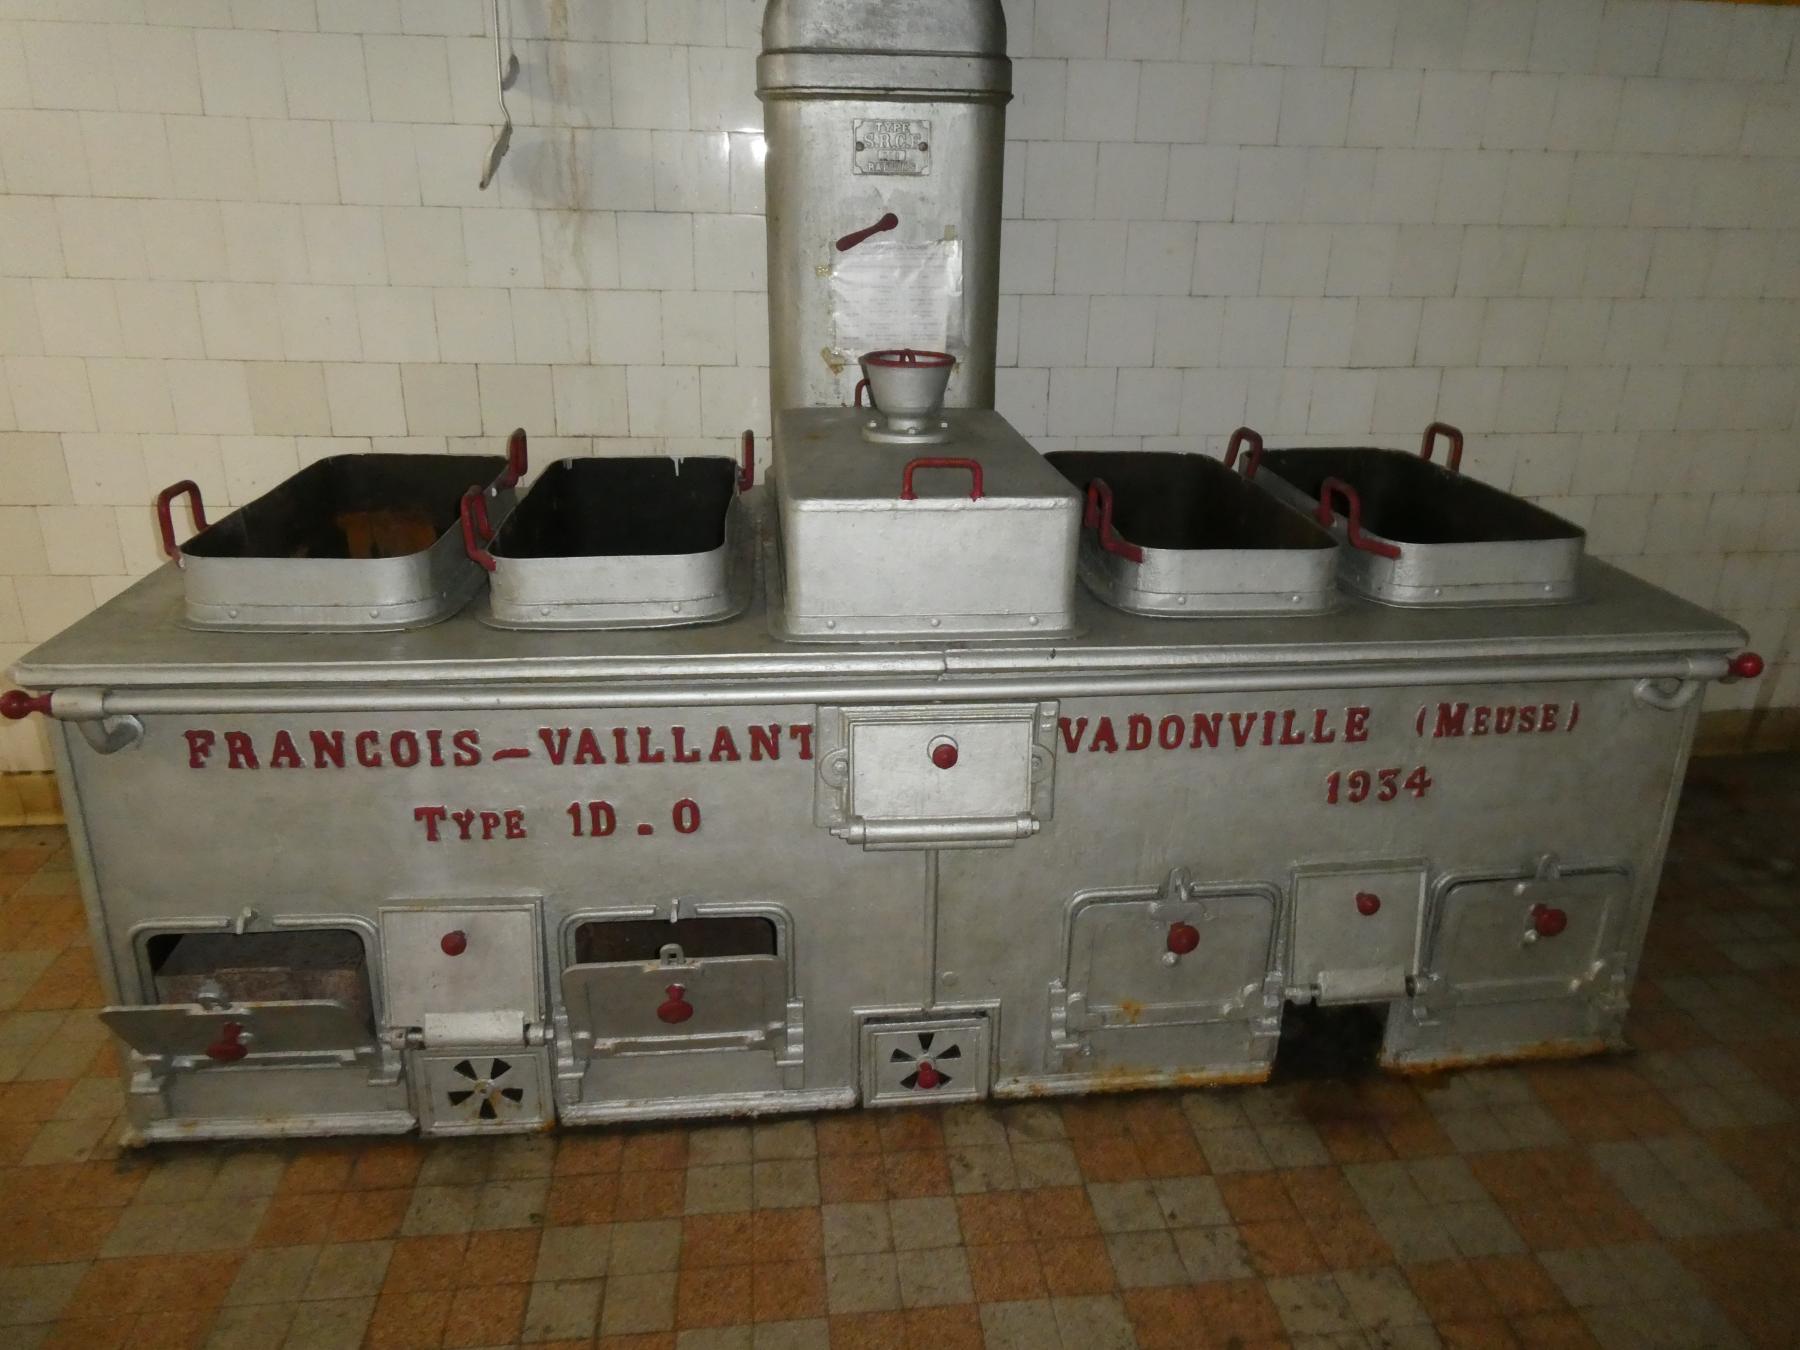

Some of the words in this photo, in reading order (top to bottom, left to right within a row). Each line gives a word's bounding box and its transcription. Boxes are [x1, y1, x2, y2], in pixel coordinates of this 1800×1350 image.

[875, 122, 911, 132] TYPE
[1058, 706, 1371, 753] VADONVILLE
[1416, 700, 1581, 738] (MEUSE)
[1325, 765, 1432, 805] 1934
[414, 804, 527, 842] TYPE
